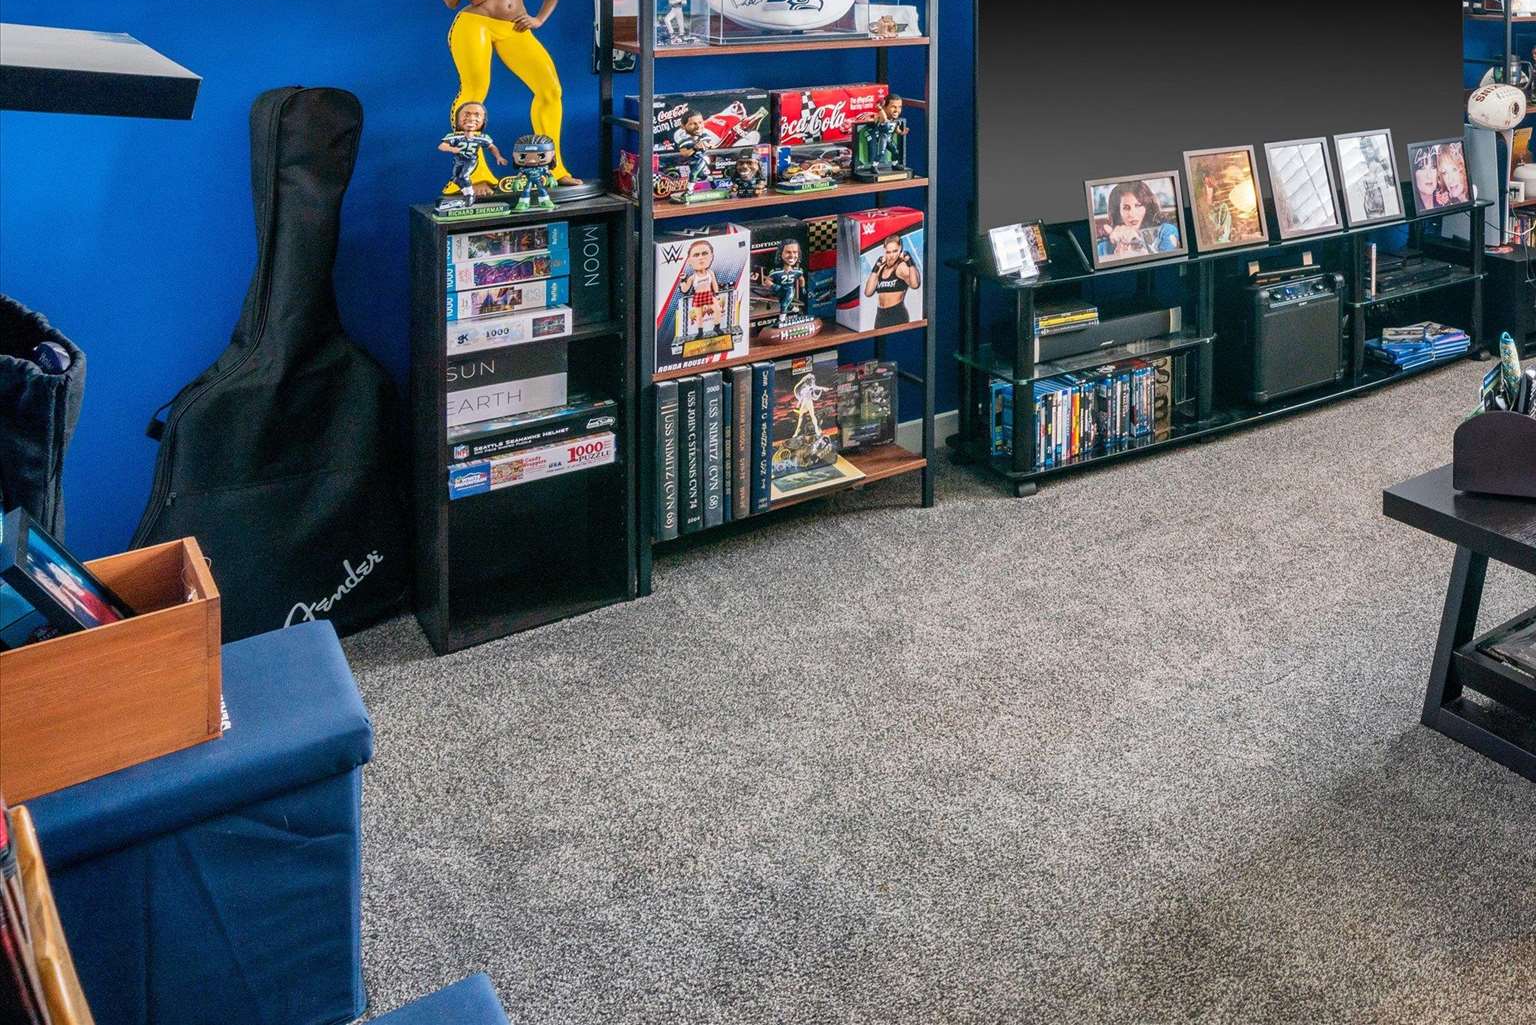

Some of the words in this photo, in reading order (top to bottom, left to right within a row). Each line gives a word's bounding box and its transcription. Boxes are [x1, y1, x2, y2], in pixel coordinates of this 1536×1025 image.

[652, 123, 670, 134] acing
[780, 100, 846, 137] oca-Cola
[448, 208, 474, 216] RICHARD
[751, 240, 782, 249] EDITION
[583, 226, 600, 287] MOON
[781, 275, 795, 284] 25
[486, 327, 510, 339] 1000
[446, 359, 496, 382] SUN
[657, 362, 682, 374] RONDA
[446, 389, 522, 416] EARTH
[687, 390, 696, 407] USS
[708, 398, 719, 418] USS
[664, 414, 674, 437] USS
[687, 407, 696, 431] JOHN
[473, 441, 503, 452] SEATTLE
[505, 433, 541, 446] SEAHAWKS
[542, 426, 570, 437] HELMET
[687, 433, 696, 441] C
[708, 422, 719, 462] NIMITZ
[567, 441, 604, 464] 1000
[664, 439, 675, 481] NIMITZ
[688, 442, 697, 480] STENNIS
[708, 464, 719, 491] (CVN
[664, 482, 675, 511] (CVN
[689, 480, 698, 499] CVN
[689, 500, 698, 509] 74
[708, 495, 719, 511] 68)
[283, 549, 384, 628] Fender
